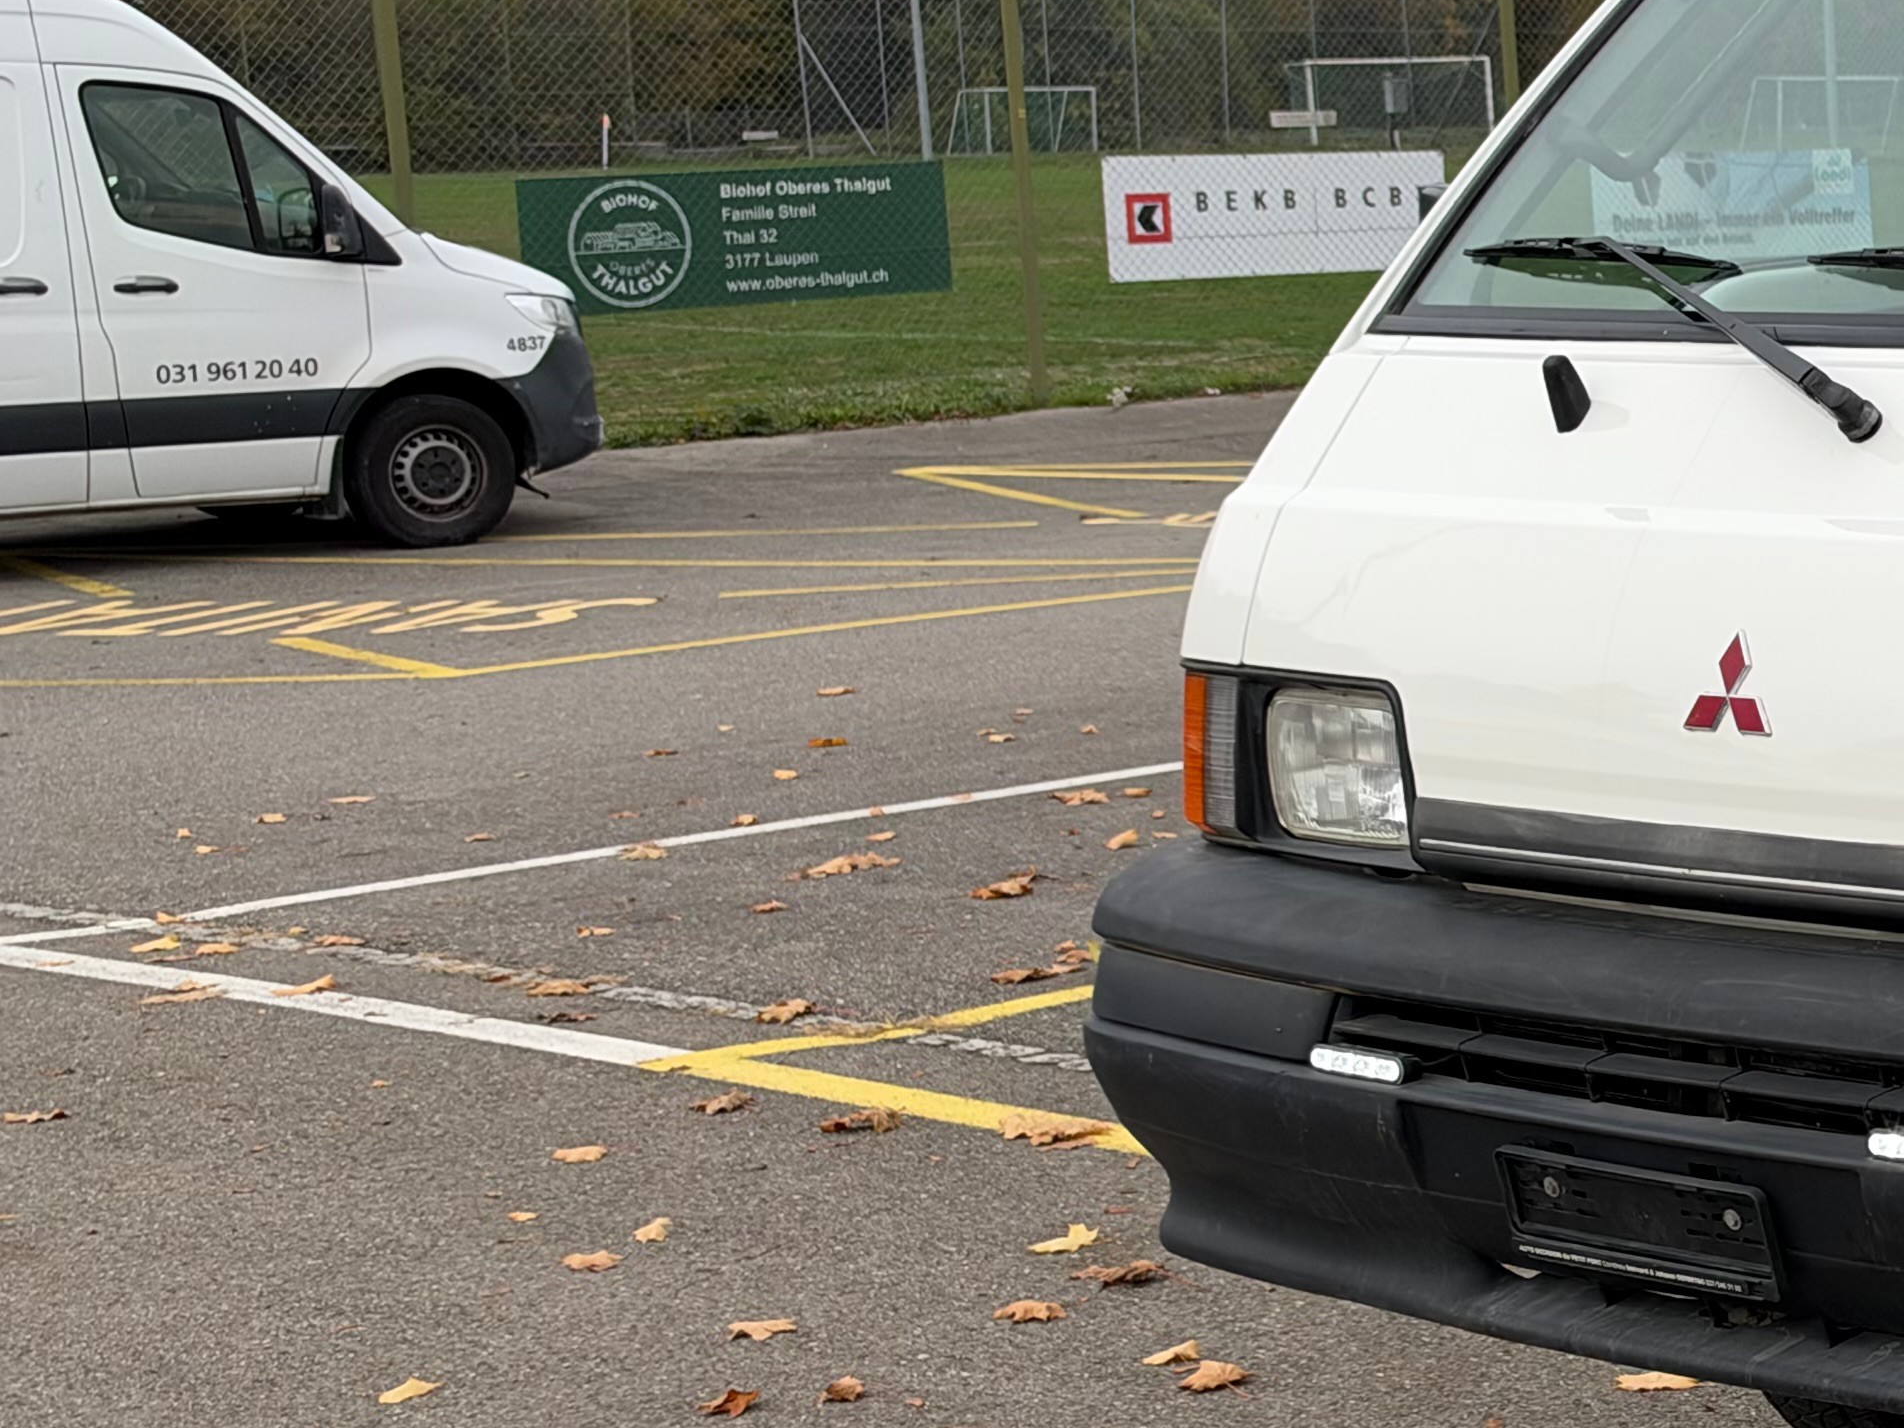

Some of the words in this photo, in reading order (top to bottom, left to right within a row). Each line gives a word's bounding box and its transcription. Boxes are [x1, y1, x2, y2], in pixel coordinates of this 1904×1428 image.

[720, 181, 771, 198] Biohof
[775, 180, 830, 195] Oberes
[834, 176, 892, 194] Thalgut
[601, 194, 660, 213] BIOHOF
[1195, 189, 1297, 212] BEKB
[722, 205, 774, 221] Familie
[723, 229, 755, 245] Thal
[759, 228, 778, 243] 32
[725, 253, 761, 269] 3177
[765, 252, 819, 268] Laupen
[592, 260, 674, 295] THALGUT
[726, 268, 889, 292] www.oberes-thalgut.ch
[506, 335, 546, 352] 4837
[156, 364, 198, 384] 031
[207, 361, 247, 381] 961
[254, 359, 283, 379] 20
[288, 357, 318, 376] 40
